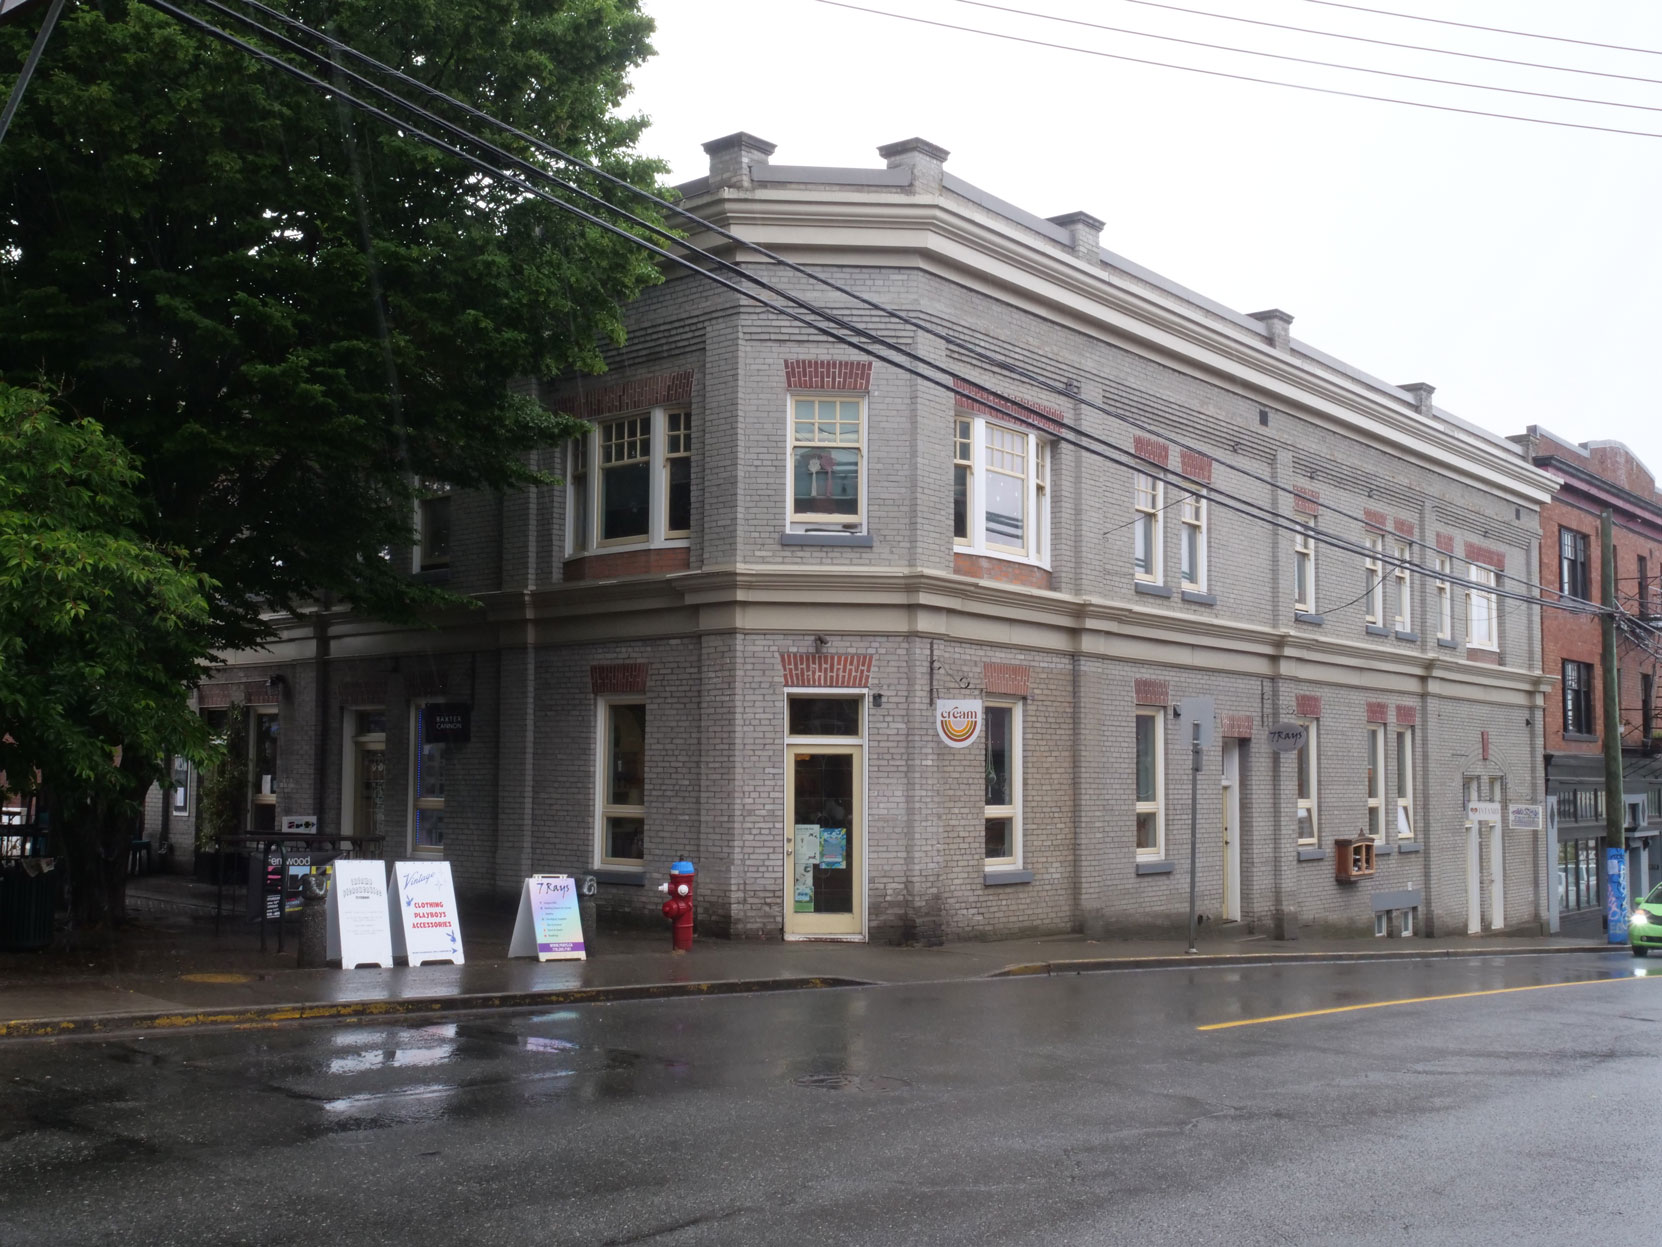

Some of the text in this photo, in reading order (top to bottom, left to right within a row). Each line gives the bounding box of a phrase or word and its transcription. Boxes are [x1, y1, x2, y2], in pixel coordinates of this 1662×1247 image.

[403, 871, 435, 890] Vintage
[536, 882, 570, 899] 7 Rays
[414, 901, 444, 909] CLOTHING
[414, 911, 447, 919] PLAYBOYS
[412, 921, 452, 929] ACCESSORIES
